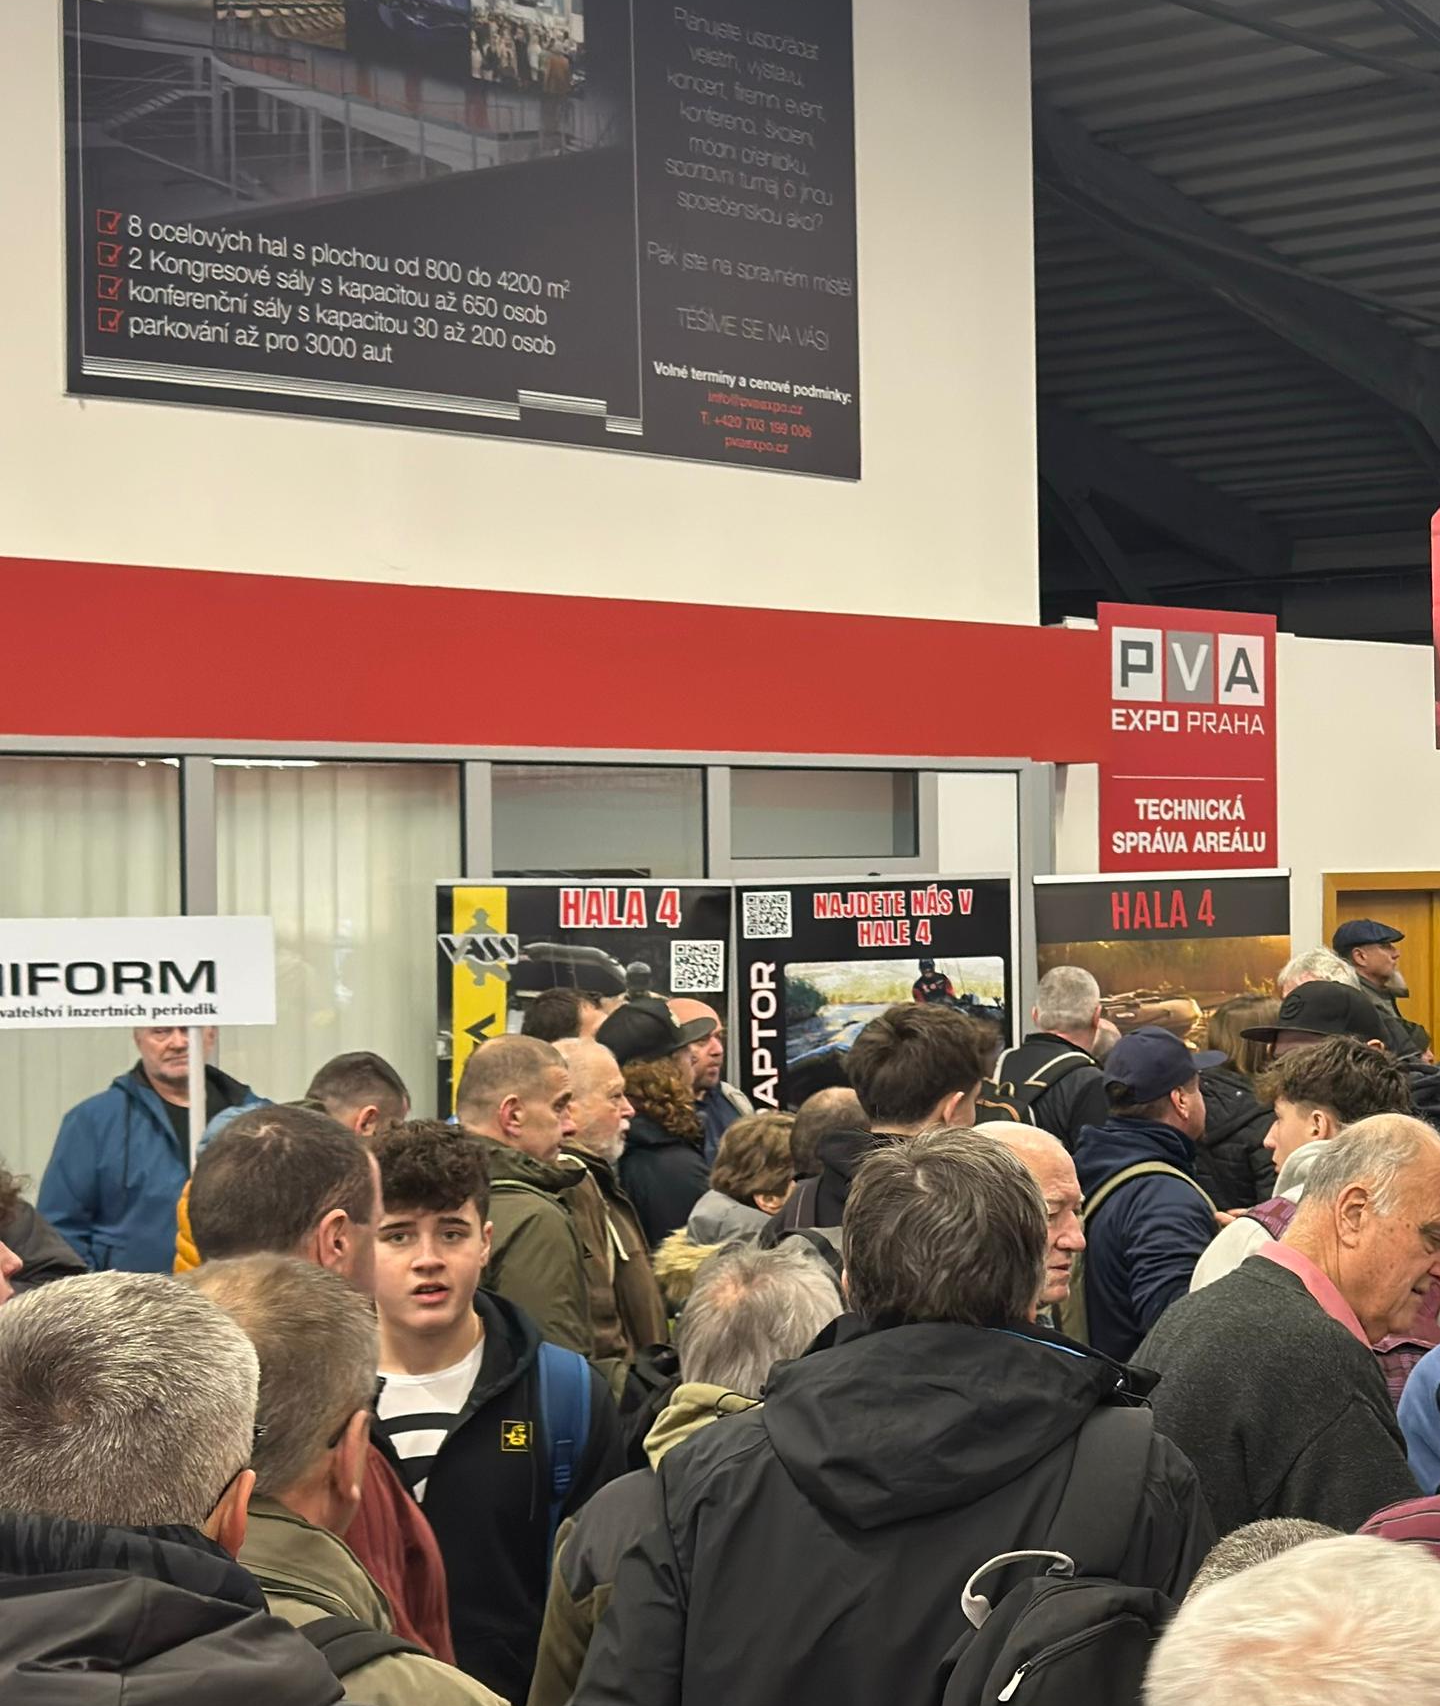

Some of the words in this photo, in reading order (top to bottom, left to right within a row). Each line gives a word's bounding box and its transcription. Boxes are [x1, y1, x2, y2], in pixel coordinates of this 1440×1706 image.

[128, 214, 143, 238] 8
[149, 222, 251, 254] ocelových
[258, 233, 288, 258] hal
[292, 243, 306, 261] s
[311, 242, 389, 273] plochou
[395, 257, 419, 278] od
[425, 258, 462, 283] 800
[467, 267, 491, 288] do
[496, 270, 542, 296] 4200
[547, 278, 571, 300] m²
[647, 241, 678, 266] Pak
[712, 258, 732, 276] na
[128, 247, 143, 270] 2
[149, 249, 271, 286] Kongresové
[276, 268, 316, 297] sály
[320, 277, 333, 295] s
[338, 275, 429, 308] kapacitou
[435, 291, 458, 312] až
[462, 294, 498, 319] 650
[503, 304, 548, 326] osob
[128, 278, 248, 315] konferenční
[253, 297, 292, 325] sály
[298, 306, 310, 324] s
[316, 303, 407, 335] kapacitou
[413, 316, 438, 339] 30
[443, 321, 466, 344] až
[471, 325, 506, 349] 200
[511, 334, 556, 356] osob
[741, 318, 764, 341] SE
[768, 322, 792, 343] NA
[128, 315, 229, 344] parkování
[235, 326, 260, 348] až
[266, 332, 299, 353] pro
[304, 333, 357, 359] 3000
[362, 343, 393, 363] aut
[653, 361, 688, 379] Volné
[691, 367, 736, 388] termíny
[739, 376, 746, 387] a
[749, 376, 791, 394] cenové
[793, 384, 852, 405] podmínky:
[713, 414, 742, 429] +420
[1120, 639, 1260, 695] PVA
[1111, 708, 1180, 733] EXPO
[1187, 711, 1265, 735] PRAHA
[1134, 794, 1246, 821] TECHNICKÁ
[1112, 826, 1188, 854] SPRÁVA
[1192, 826, 1266, 853] AREÁLU
[559, 887, 648, 929] HALA
[655, 887, 682, 929] 4
[813, 890, 906, 919] NAJDETE
[911, 883, 953, 918] NÁS
[958, 888, 973, 915] V
[1111, 889, 1189, 931] HALA
[1197, 888, 1216, 927] 4
[857, 920, 911, 947] HALE
[915, 919, 932, 944] 4
[0, 960, 217, 996] IFORM
[68, 1004, 147, 1018] inzertních
[152, 1003, 218, 1020] periodik
[750, 960, 779, 1114] APTOR
